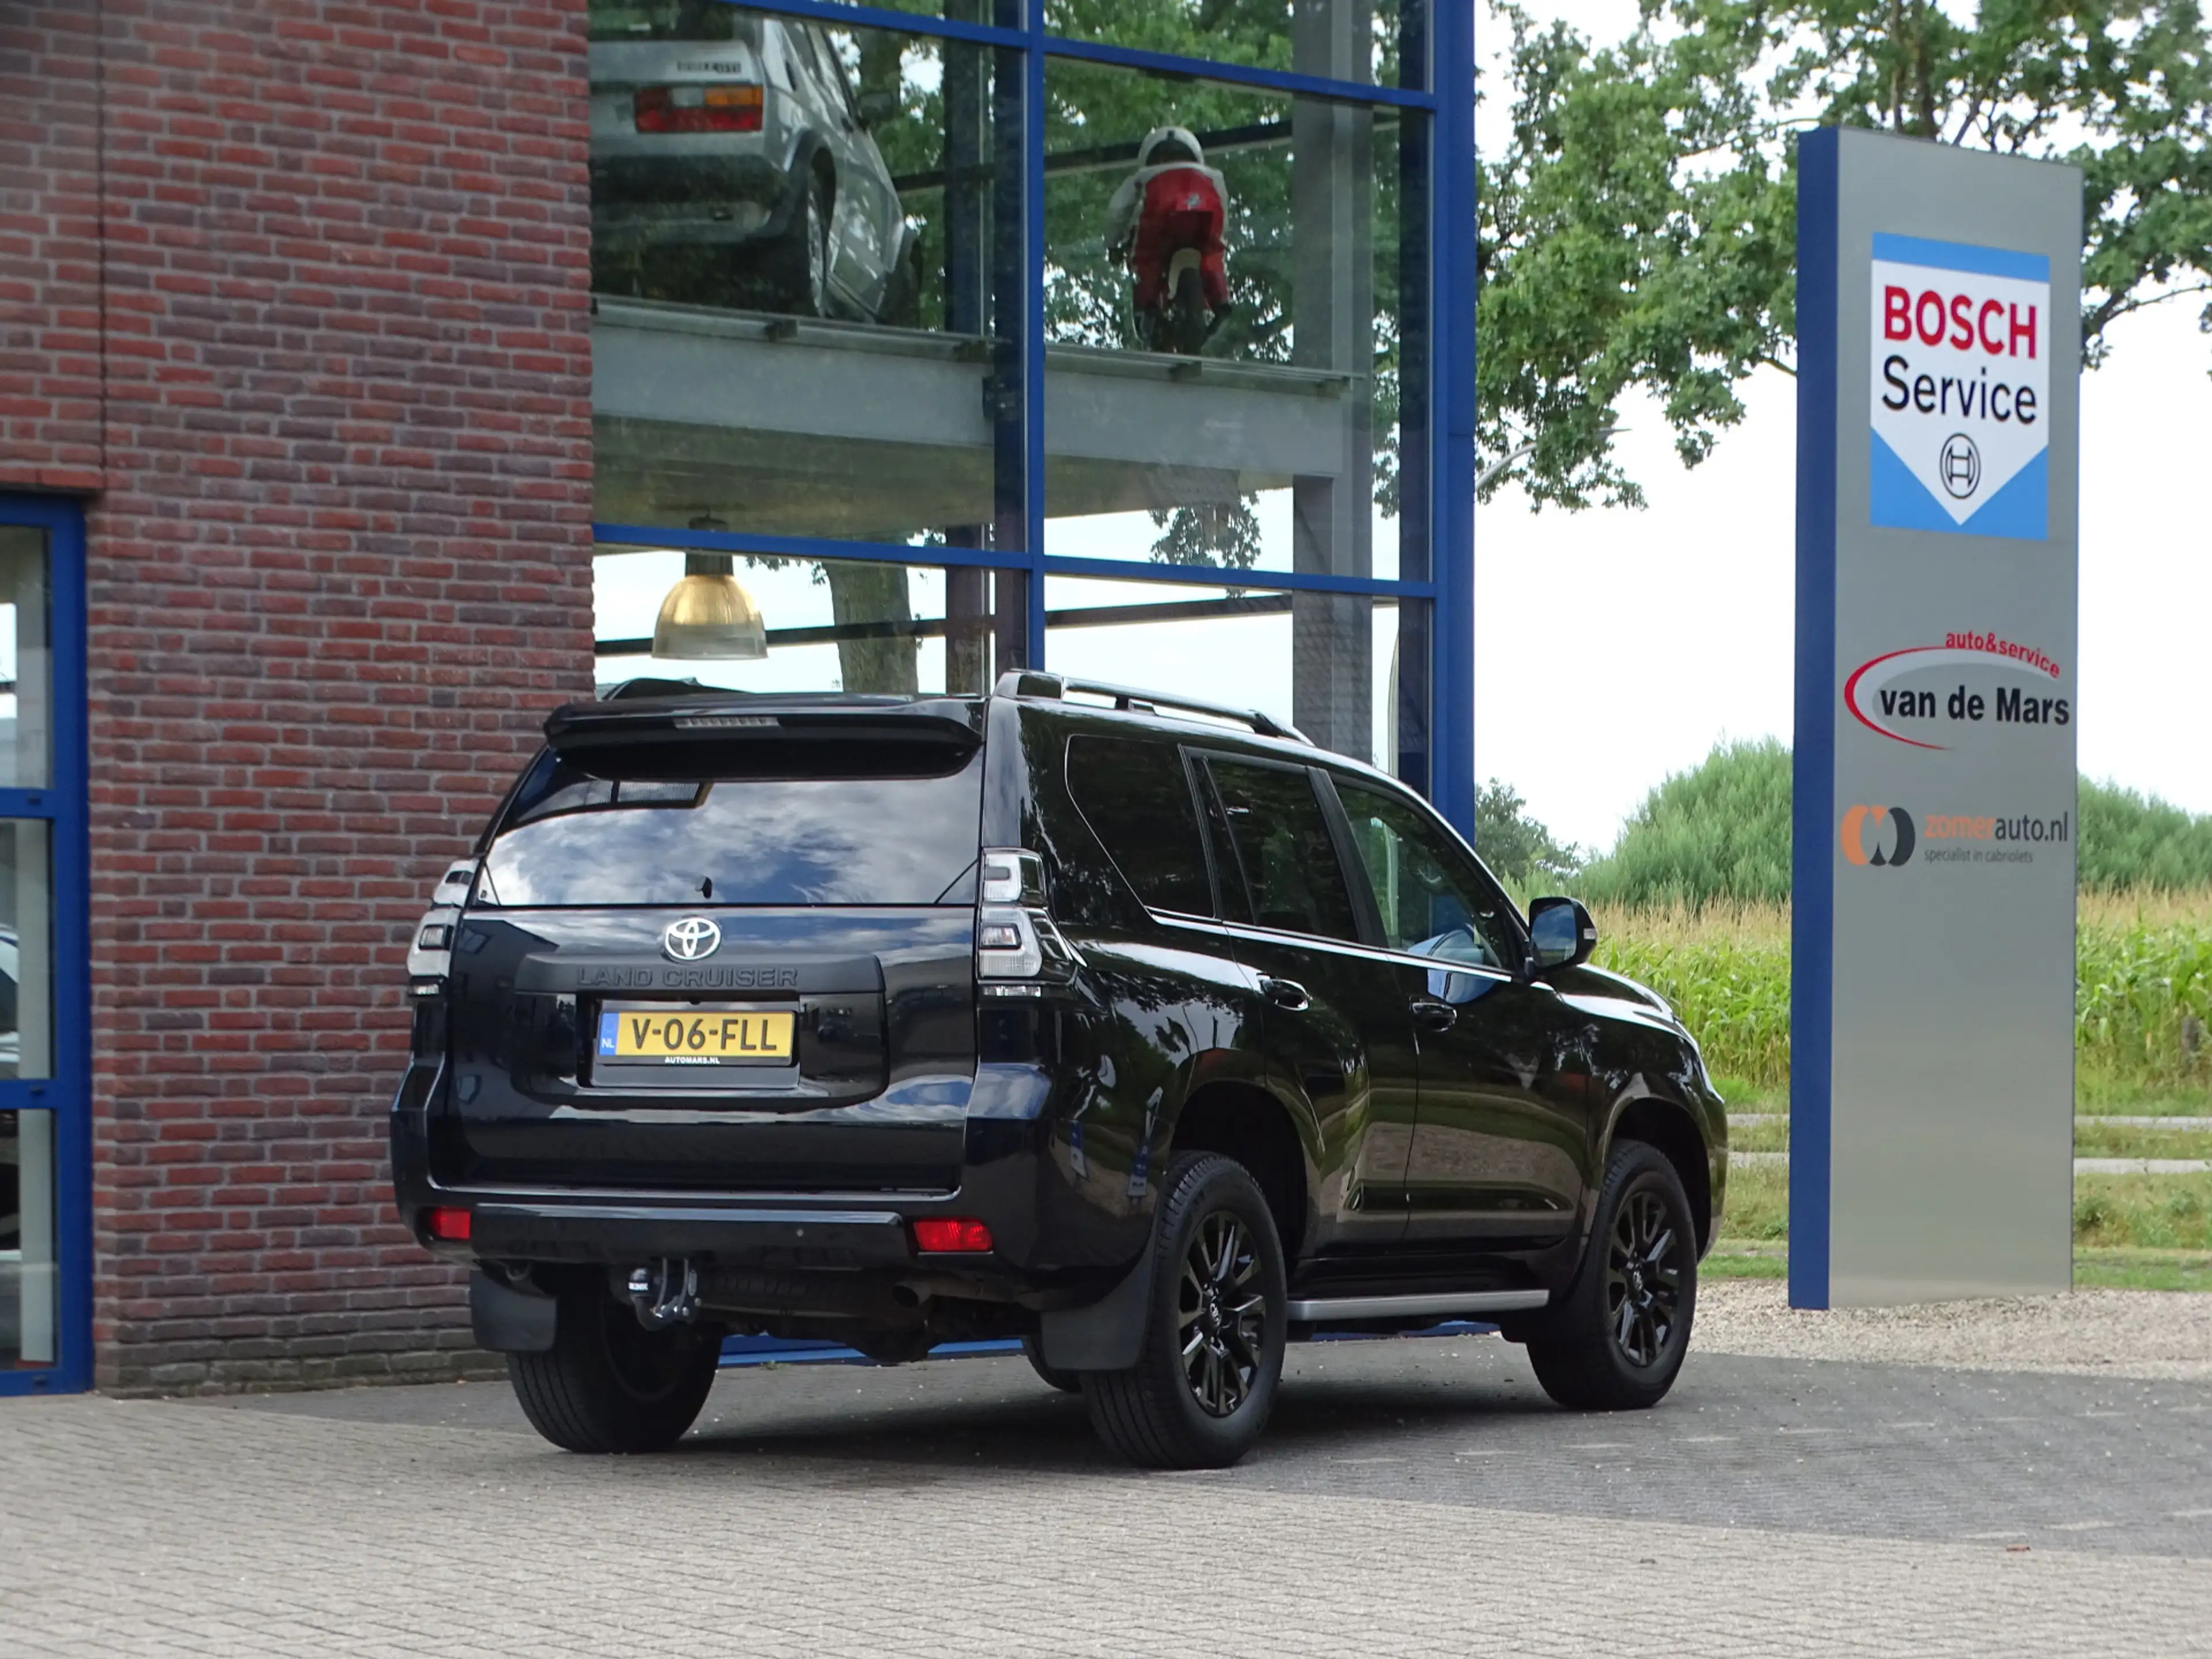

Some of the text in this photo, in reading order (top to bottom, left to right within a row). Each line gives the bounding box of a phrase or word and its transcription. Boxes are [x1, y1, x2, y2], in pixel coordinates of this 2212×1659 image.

[1884, 285, 2037, 359] BOSCH
[1882, 354, 2037, 425] Service
[1945, 631, 2061, 679] auto&service
[1880, 685, 2070, 725] van de Mars
[1924, 812, 2068, 842] zomerauto.nl
[1924, 847, 2033, 863] specialist in cabriolets
[577, 967, 797, 987] LAND CRUISER
[601, 1039, 615, 1048] NL
[632, 1018, 777, 1050] V-06-FLL
[664, 1056, 721, 1065] AUTOMARS.NL
